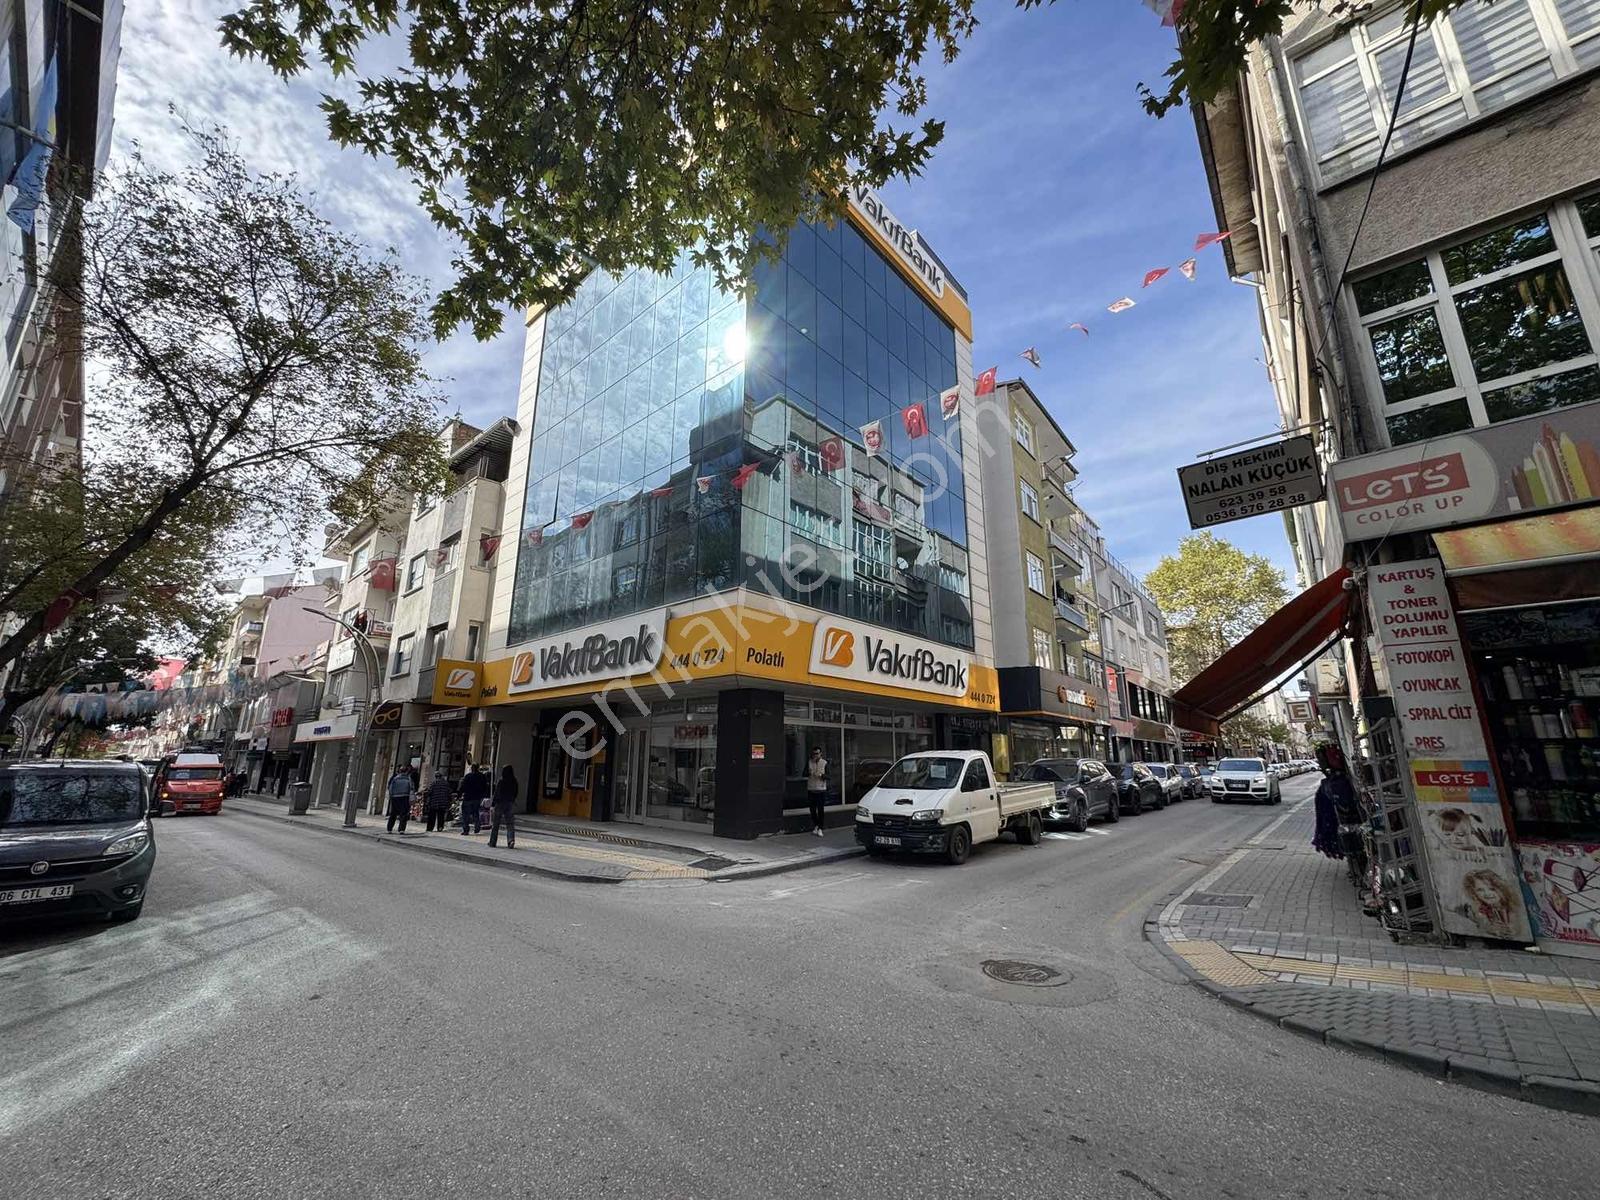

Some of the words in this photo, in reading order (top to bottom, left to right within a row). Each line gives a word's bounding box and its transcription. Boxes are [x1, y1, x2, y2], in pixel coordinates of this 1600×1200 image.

[854, 184, 942, 294] VakıfBank
[1232, 446, 1286, 470] HEKİMİ
[1188, 473, 1243, 498] NALAN
[1248, 455, 1313, 484] KÜÇÜK
[1219, 495, 1244, 508] 623
[1248, 490, 1265, 501] 39
[1269, 485, 1287, 497] 58
[1205, 509, 1237, 523] 0536
[1240, 503, 1264, 515] 576
[1268, 498, 1284, 508] 28
[1289, 493, 1306, 504] 38
[1356, 502, 1425, 525] COLOR
[1435, 495, 1464, 510] UP
[1377, 567, 1436, 584] KARTUŞ
[1403, 584, 1415, 594] &
[1387, 596, 1438, 610] TONER
[1383, 609, 1449, 625] DOLUMU
[1391, 624, 1449, 639] YAPILIR
[746, 646, 785, 668] Polatlı
[862, 635, 967, 690] VakıfBank
[1448, 703, 1473, 719] CİLT
[0, 891, 14, 901] 06
[21, 888, 42, 899] CTL
[50, 886, 71, 896] 431
